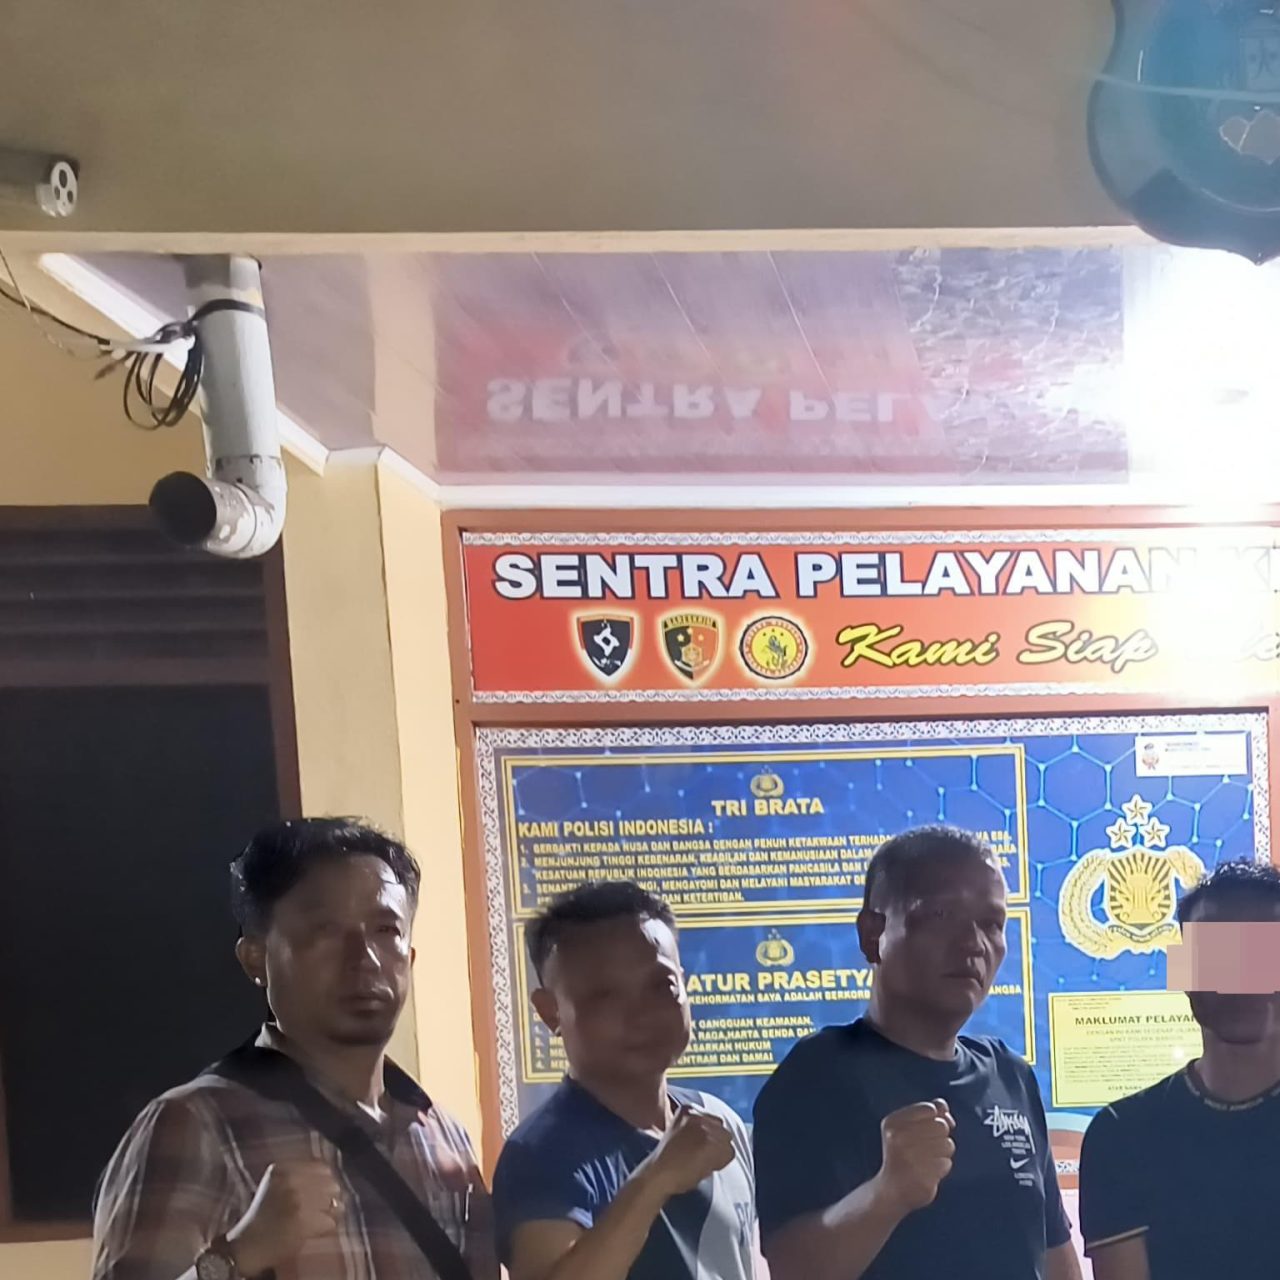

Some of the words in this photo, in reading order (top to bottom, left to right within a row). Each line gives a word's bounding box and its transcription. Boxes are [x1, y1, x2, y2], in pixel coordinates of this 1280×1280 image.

[495, 550, 777, 599] SENTRA
[838, 623, 998, 670] Kami
[1016, 620, 1158, 676] Siap
[711, 799, 747, 817] TRI
[754, 797, 825, 816] BRATA
[518, 822, 559, 838] KAMI
[563, 820, 614, 837] POLISI
[619, 818, 705, 836] INDONESIA
[533, 843, 582, 854] BERBAKTI
[583, 842, 621, 853] KEPADA
[623, 841, 649, 852] NUSA
[651, 841, 671, 851] DAN
[672, 839, 711, 850] BANGSA
[713, 838, 752, 850] DENGAN
[754, 837, 787, 848] PENUH
[788, 836, 847, 848] KETAKWAAN
[534, 856, 600, 867] MENJUNJUNG
[602, 855, 636, 866] TINGGI
[700, 852, 747, 863] KEADILAN
[749, 851, 768, 861] DAN
[770, 849, 838, 861] KEMANUSIAAN
[534, 869, 586, 881] KESATUAN
[587, 868, 635, 879] REPUBLIK
[637, 867, 689, 878] INDONESIA
[690, 865, 716, 877] YANG
[718, 864, 787, 876] BERDASARKAN
[789, 863, 840, 874] PANCASILA
[842, 861, 862, 872] DAN
[662, 879, 718, 891] MENGAYOMI
[720, 878, 739, 889] DAN
[742, 877, 788, 888] MELAYANI
[789, 875, 851, 887] MASYARAKAT
[686, 972, 752, 993] ATUR
[757, 991, 783, 1003] SAYA
[784, 990, 823, 1002] ADALAH
[825, 989, 871, 1000] BERKORB
[699, 1018, 754, 1029] GANGGUAN
[1075, 1015, 1143, 1026] MAKLUMAT
[1146, 1013, 1195, 1024] PELAYA
[762, 1028, 795, 1039] BENDA
[735, 1040, 771, 1051] HUKUM
[720, 1052, 740, 1063] DAN
[742, 1051, 774, 1063] DAMAI
